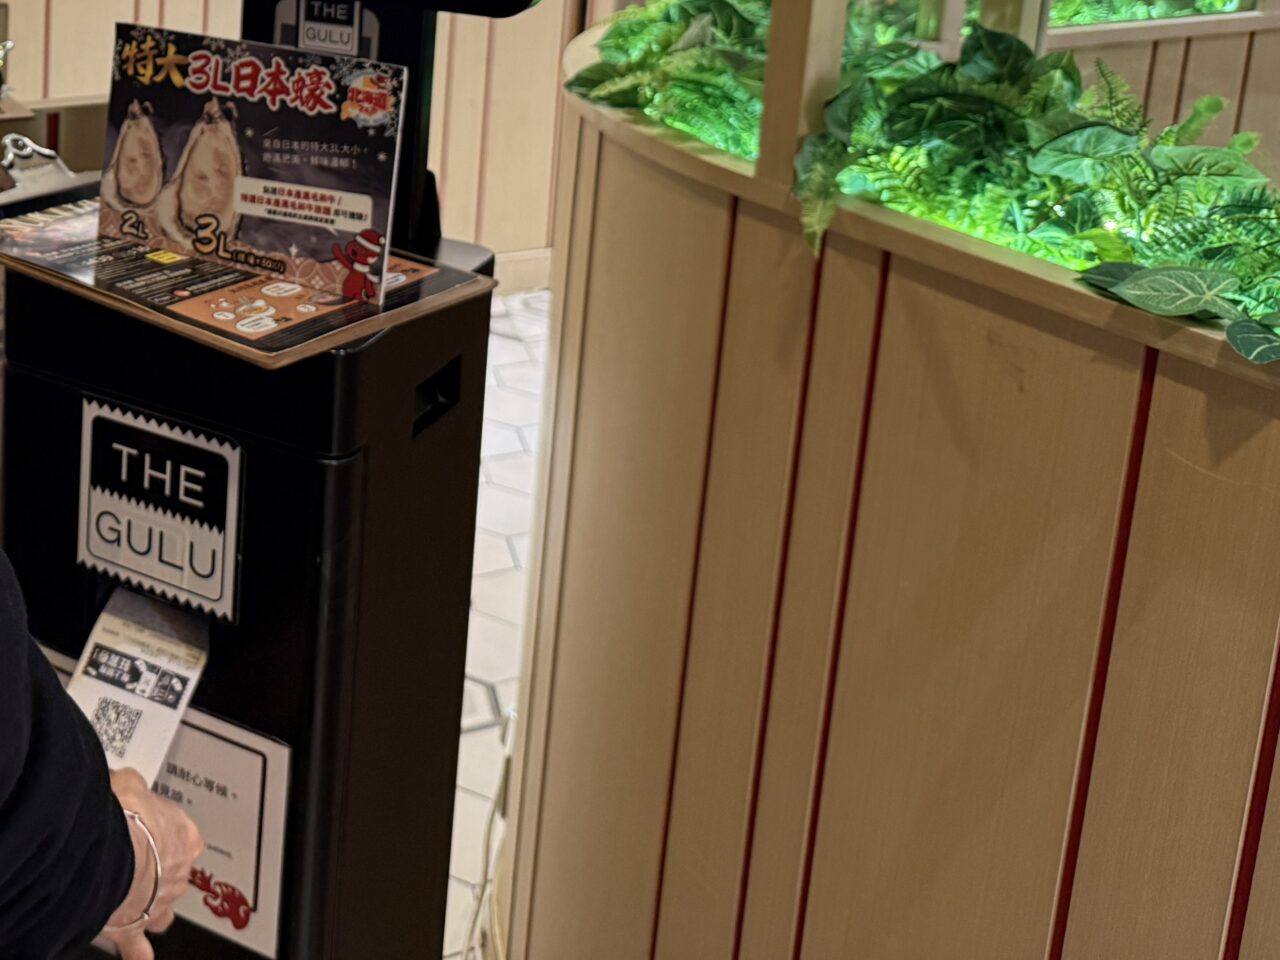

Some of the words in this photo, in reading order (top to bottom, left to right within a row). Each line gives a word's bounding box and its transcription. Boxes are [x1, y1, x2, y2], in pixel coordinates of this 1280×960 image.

[310, 1, 350, 20] THE
[305, 27, 351, 45] GULU
[121, 210, 148, 239] 2L
[193, 214, 233, 260] 3L
[112, 442, 206, 509] THE
[95, 509, 217, 579] GULU
